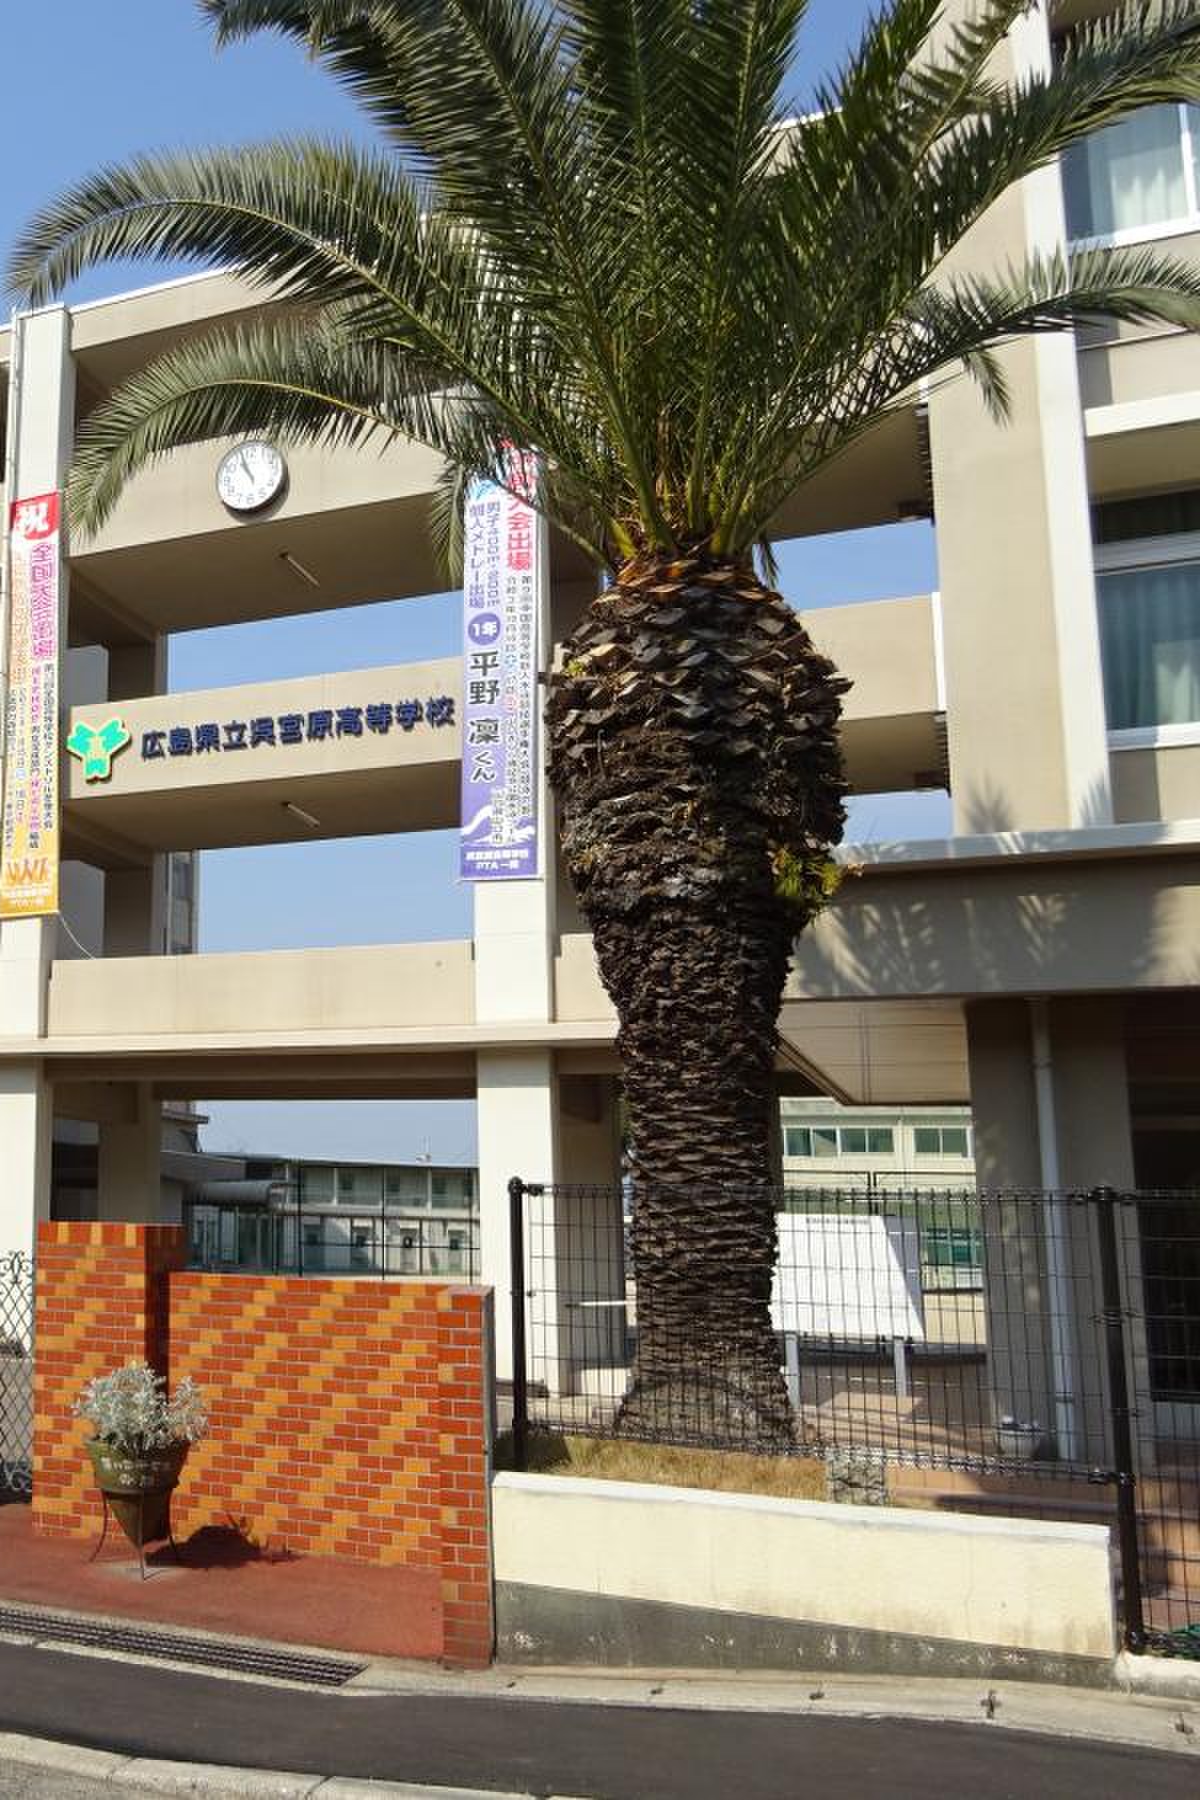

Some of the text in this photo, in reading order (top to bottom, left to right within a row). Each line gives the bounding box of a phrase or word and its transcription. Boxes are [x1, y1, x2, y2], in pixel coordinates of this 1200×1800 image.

[16, 502, 49, 533] 祝
[471, 621, 498, 638] 1年
[467, 650, 502, 706] 平野
[140, 696, 456, 760] 広島県立呉宮原高等学校
